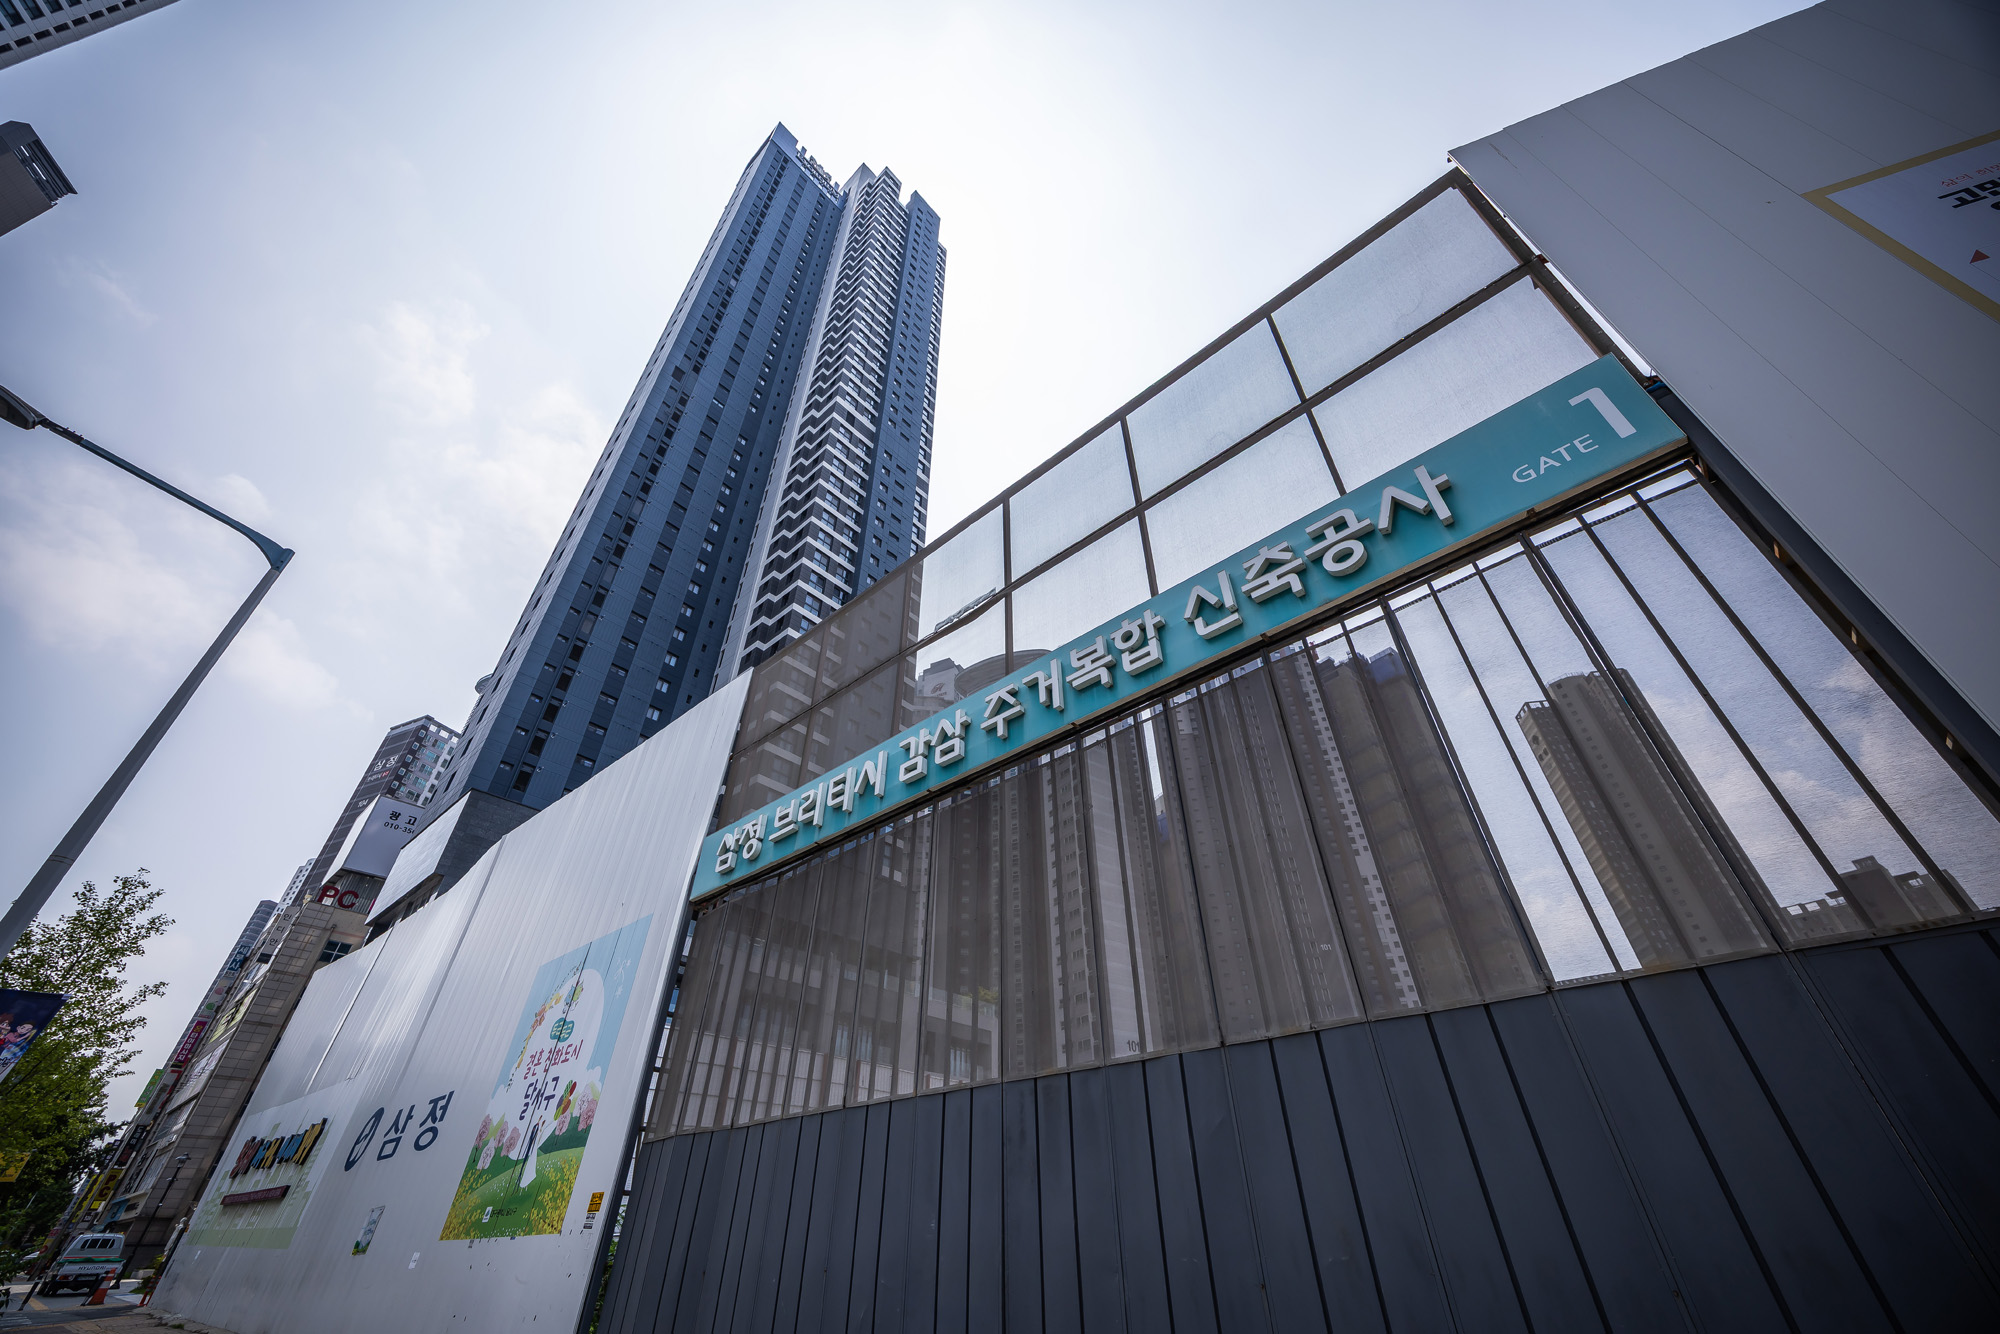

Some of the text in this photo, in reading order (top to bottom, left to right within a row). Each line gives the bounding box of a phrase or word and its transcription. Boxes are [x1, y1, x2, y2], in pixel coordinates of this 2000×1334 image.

[1568, 387, 1638, 439] 1
[1512, 433, 1601, 484] GATE
[714, 464, 1453, 875] 삼정 브리티시 감삼 주거복합 신축공사
[389, 810, 418, 826] 광고
[316, 885, 360, 910] PC
[269, 912, 293, 947] 인디안
[1320, 943, 1332, 951] 101
[523, 1039, 584, 1081] 결혼 친화도시
[519, 1075, 561, 1121] 달서구
[376, 1090, 455, 1162] 삼정
[98, 1174, 118, 1198] PC
